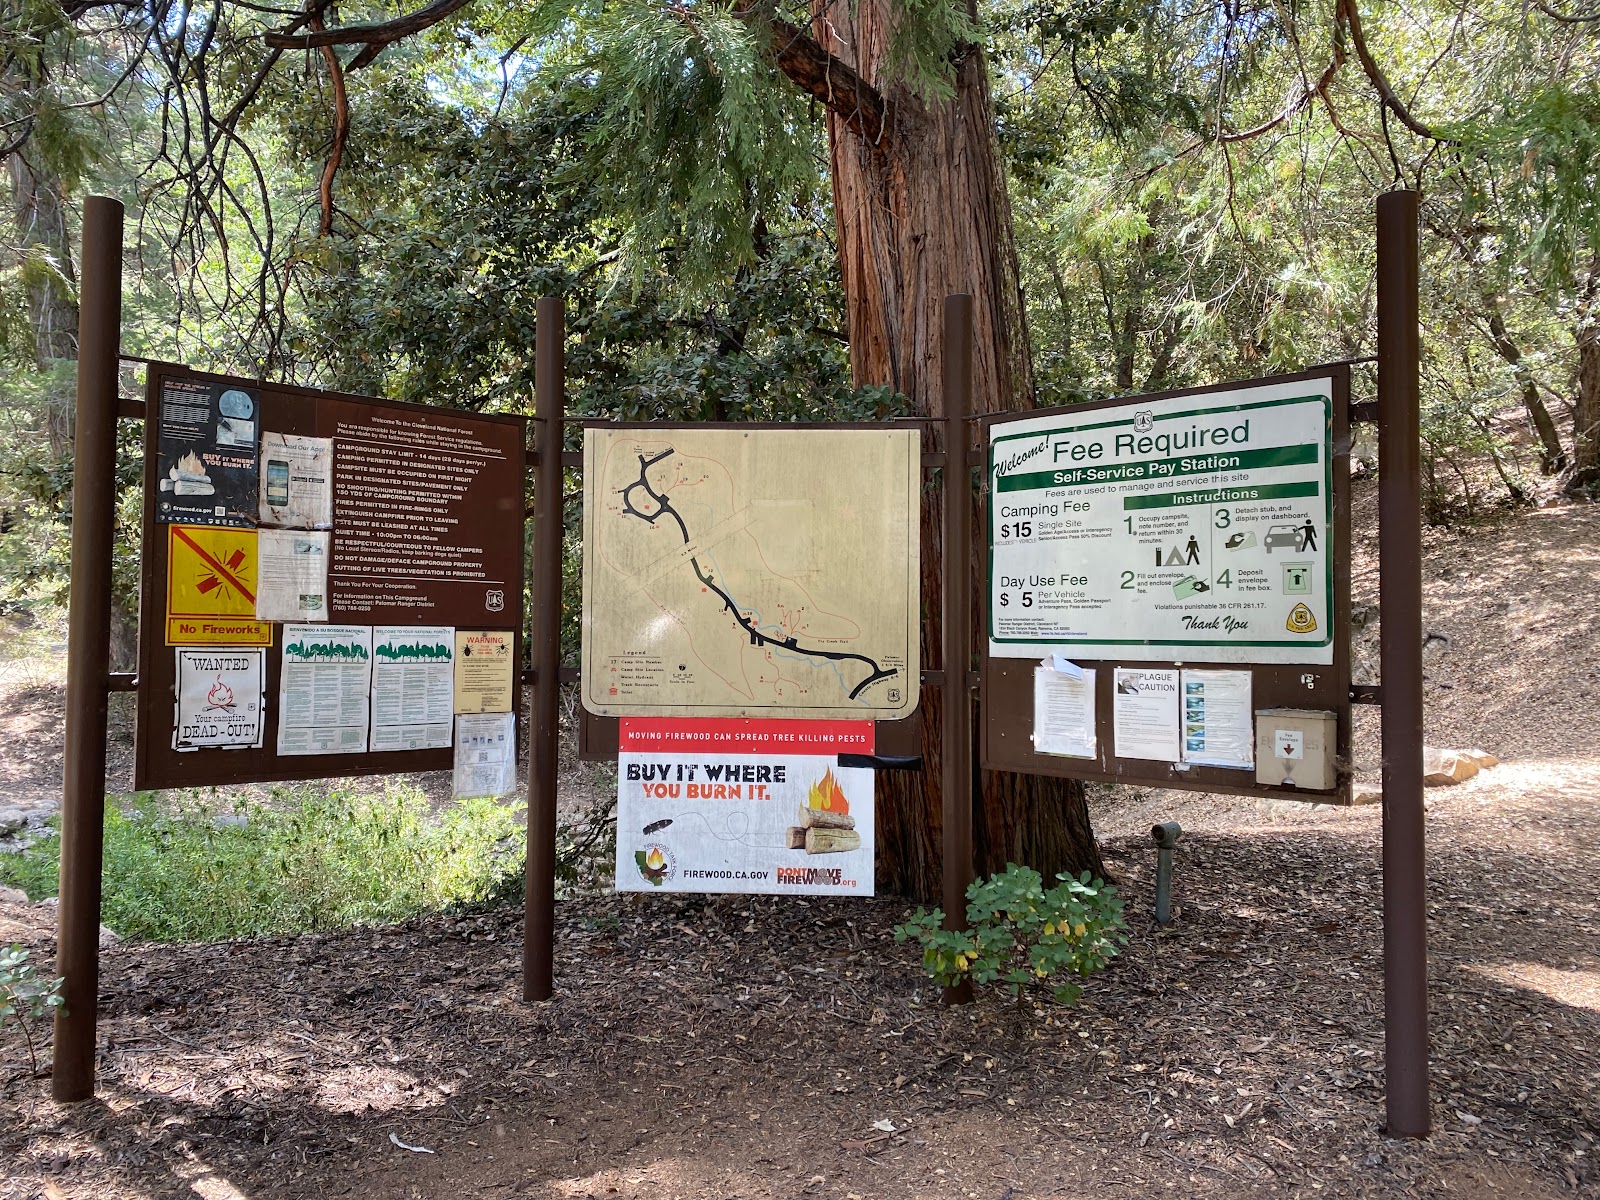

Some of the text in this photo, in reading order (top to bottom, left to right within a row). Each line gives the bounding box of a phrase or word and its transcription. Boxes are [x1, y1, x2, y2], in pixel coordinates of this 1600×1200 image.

[337, 444, 380, 453] CAMPGROUND
[1053, 420, 1250, 462] Fee Required
[994, 435, 1050, 478] Welcome!
[409, 462, 445, 470] DESIGNATED
[1054, 454, 1239, 483] Self-Service Pay Station
[363, 476, 401, 484] DESIGNATED
[402, 480, 451, 489] SITES/PAVEMENT
[1045, 489, 1065, 497] Fees
[1084, 486, 1105, 494] used
[1119, 483, 1154, 492] manage
[1157, 479, 1173, 488] and
[1176, 476, 1208, 486] service
[1211, 474, 1228, 483] this
[1231, 472, 1248, 481] site
[1173, 489, 1258, 504] Instructions
[1000, 501, 1090, 517] Camping Fee
[1271, 512, 1310, 521] dashboard.
[1038, 521, 1062, 529] Single
[1215, 509, 1230, 529] 3
[1001, 522, 1031, 539] $ 15
[1001, 574, 1087, 588] Day Use Fee
[1120, 571, 1135, 590] 2
[1217, 569, 1232, 588] 4
[1000, 592, 1032, 607] $ 5
[180, 624, 260, 634] No Fireworks
[1182, 616, 1220, 630] Thank
[1222, 616, 1248, 634] You
[192, 658, 249, 670] WANTED
[1139, 673, 1172, 682] PLAGUE
[1138, 682, 1175, 692] CAUTION
[214, 715, 245, 724] campfire
[627, 764, 785, 782] BUY IT WHERE
[642, 784, 770, 800] YOU BURN IT.
[644, 843, 670, 852] FIREWOOD
[683, 870, 769, 880] FIREWOOD.CA.GOV
